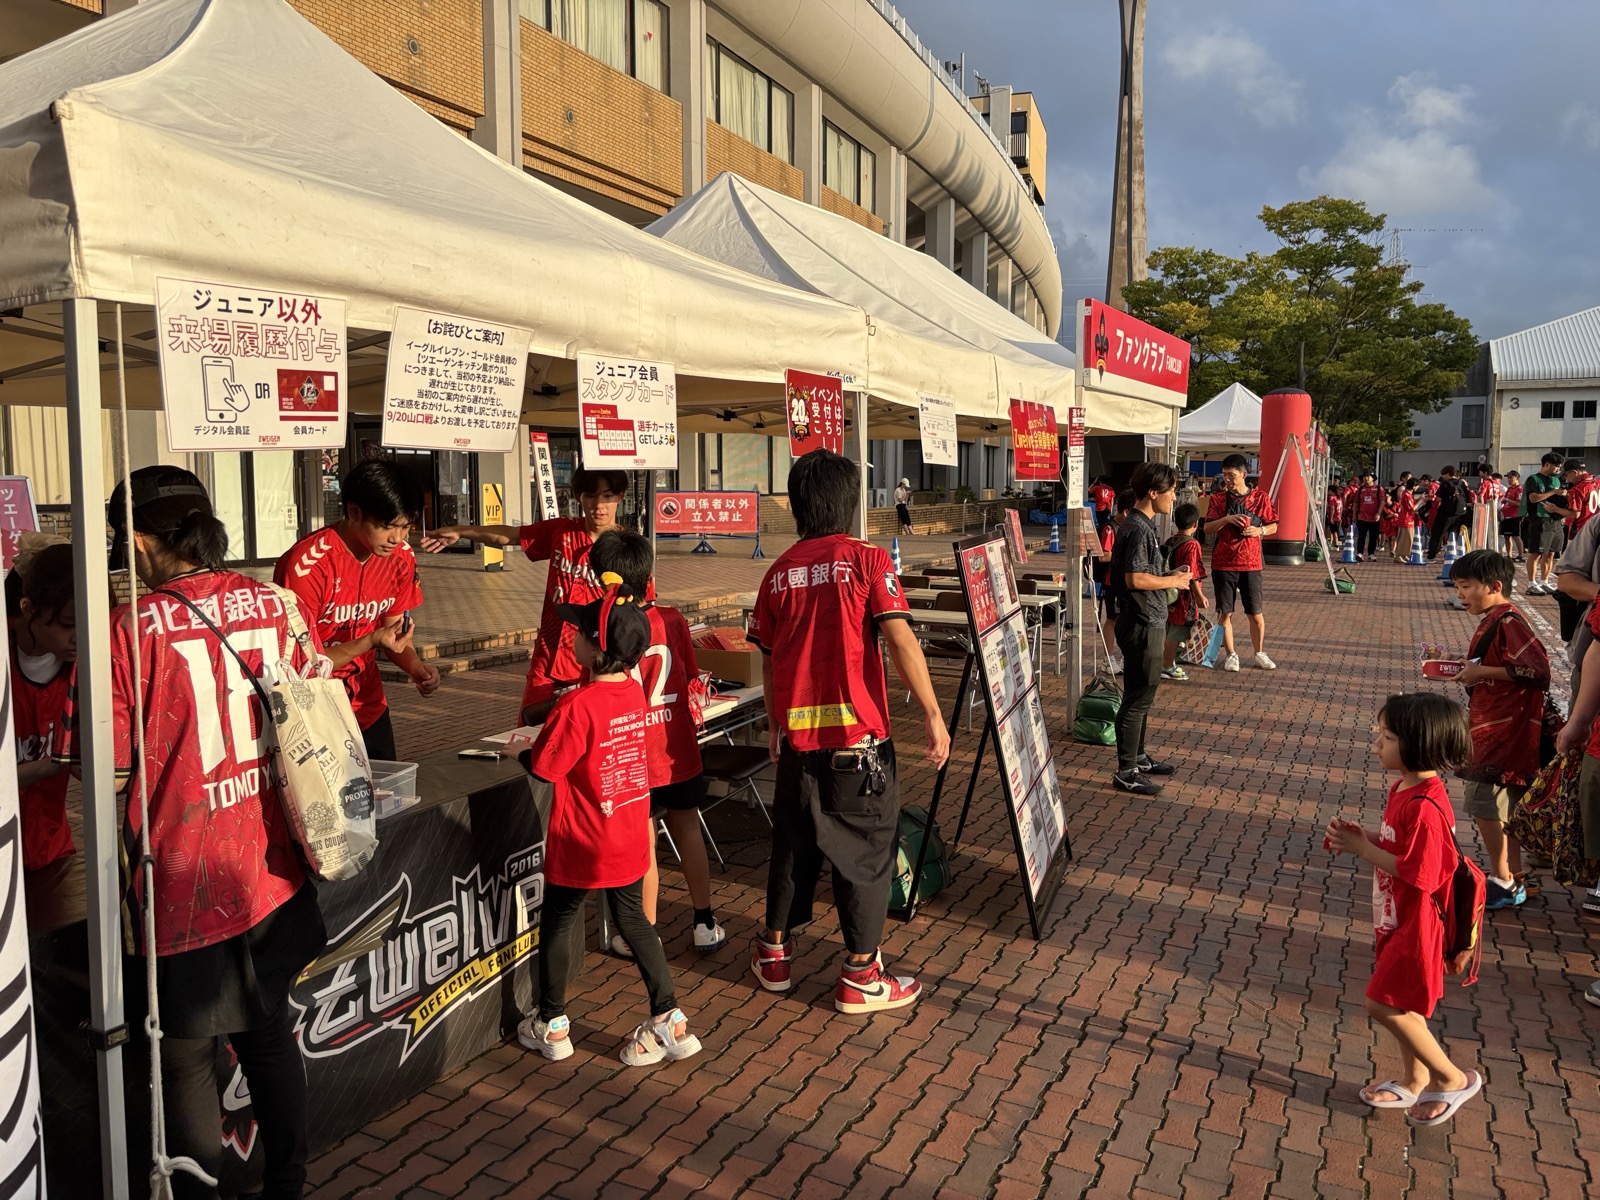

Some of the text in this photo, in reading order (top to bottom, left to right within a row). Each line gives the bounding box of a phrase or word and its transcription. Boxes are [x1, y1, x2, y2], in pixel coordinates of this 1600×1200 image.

[192, 288, 323, 327] ジュニア以外
[168, 314, 341, 363] 来場履歴付与
[426, 318, 506, 346] 【お詫びとご案内】
[1115, 328, 1167, 375] ファンクラブ
[595, 361, 659, 382] ジュニア会員
[254, 382, 270, 399] OR
[581, 377, 675, 406] スタンプカード
[810, 386, 841, 404] イベント
[811, 402, 842, 420] 受付は
[1510, 397, 1520, 410] 3
[193, 425, 251, 436] デジタル会員証
[292, 425, 328, 436] 会員カード
[637, 420, 675, 434] 選手カードを
[814, 420, 842, 437] こちら
[638, 434, 670, 446] GETしよう
[486, 505, 501, 517] VIP
[684, 498, 750, 509] 関係者以外
[691, 511, 743, 522] 立入禁止
[769, 560, 853, 595] 北國銀行
[139, 584, 284, 636] 北國銀行
[510, 851, 541, 878] 2016
[487, 932, 537, 973] FANCLUB
[418, 965, 481, 1021] OFFICIAL
